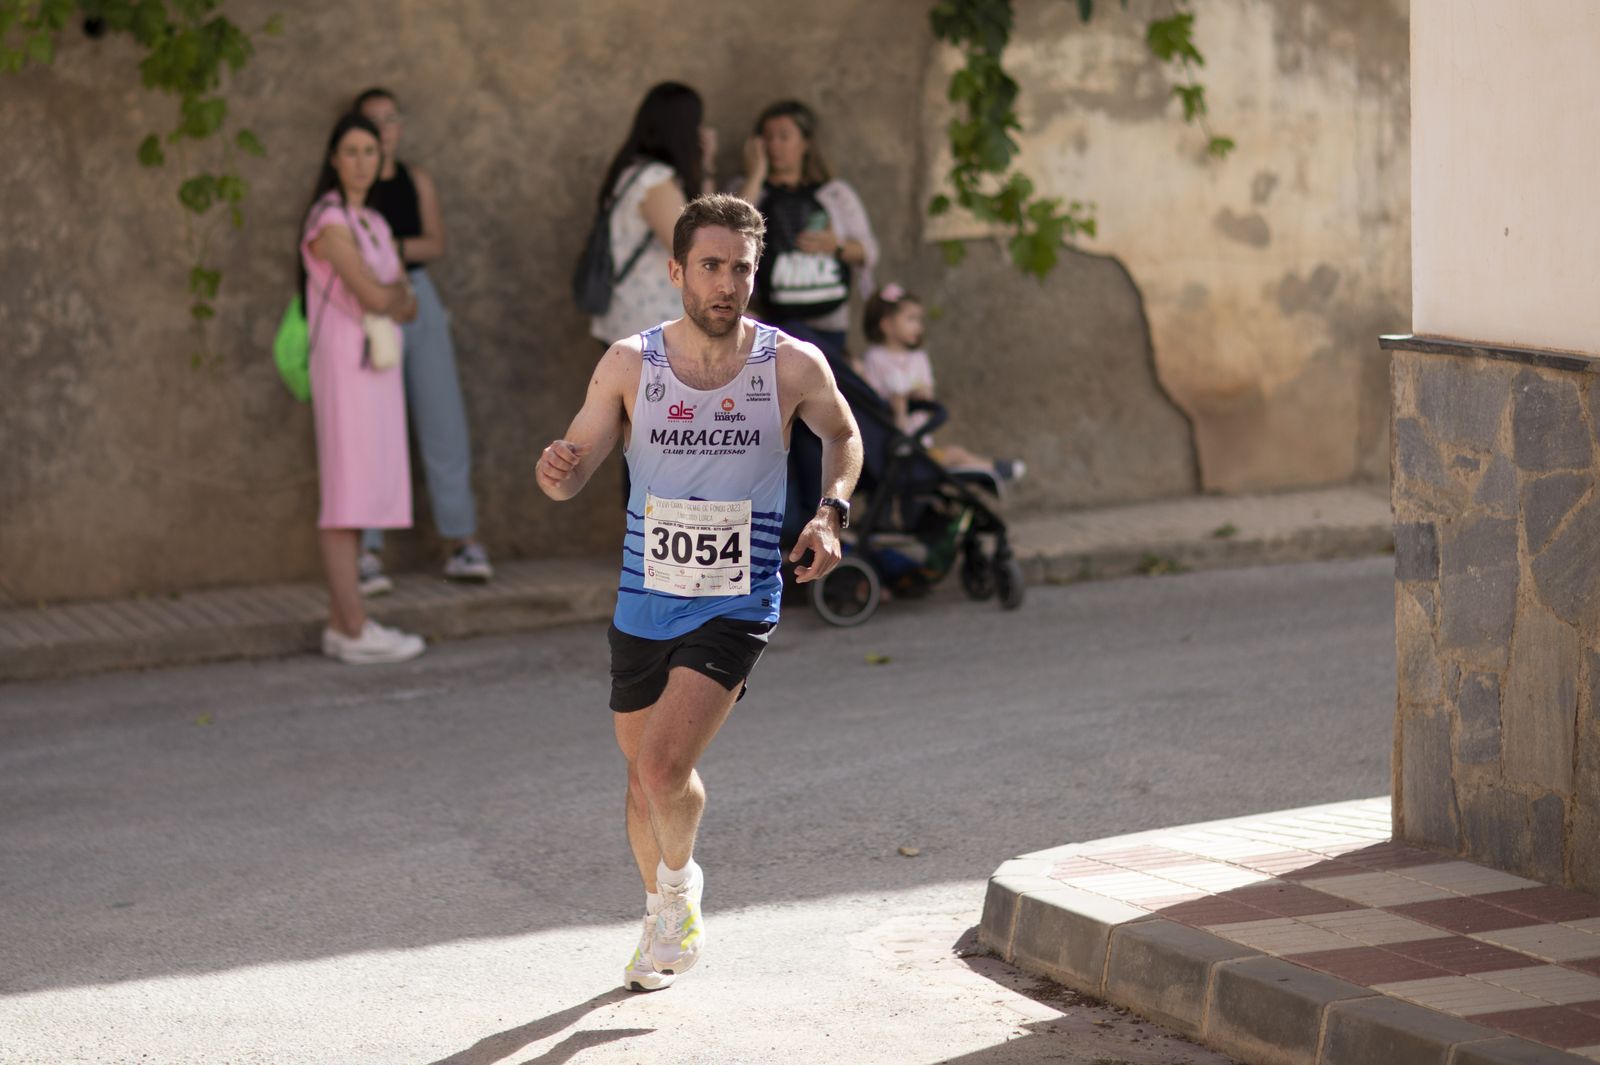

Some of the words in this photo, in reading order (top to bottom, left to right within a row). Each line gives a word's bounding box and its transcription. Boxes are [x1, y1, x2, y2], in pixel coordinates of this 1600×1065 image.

[714, 412, 746, 423] mayfo
[650, 429, 760, 446] MARACENA
[651, 527, 742, 566] 3054
